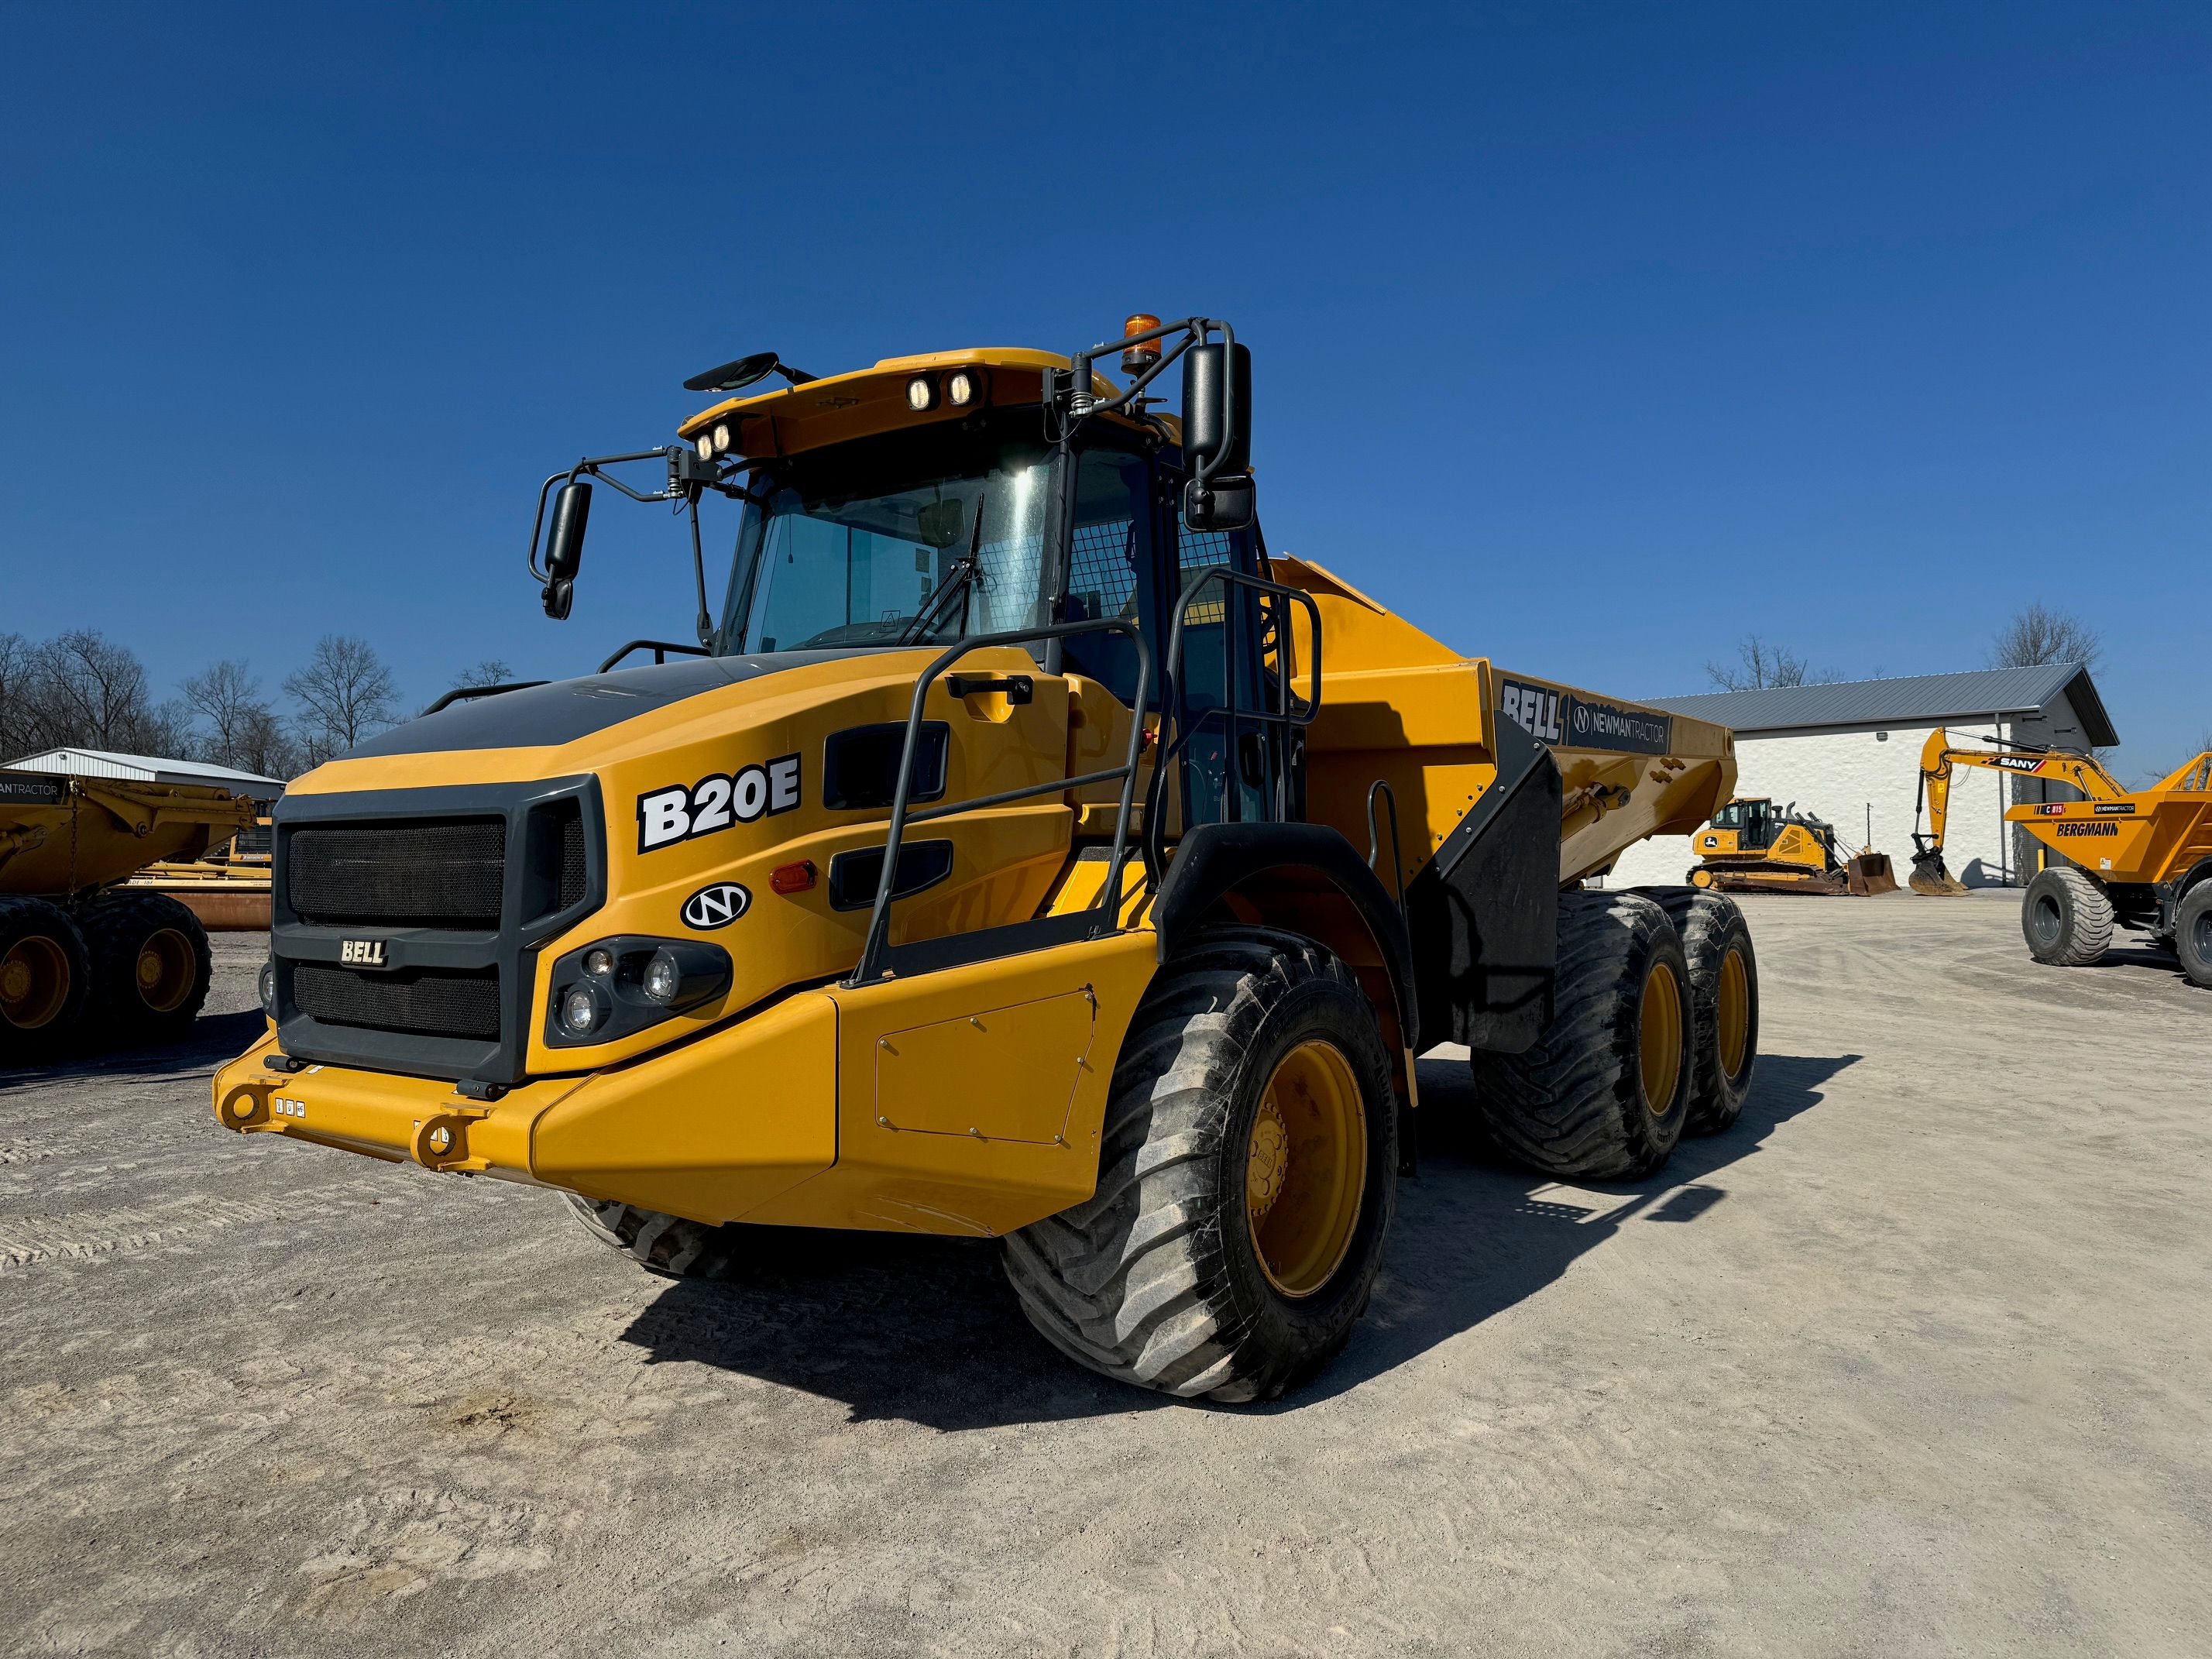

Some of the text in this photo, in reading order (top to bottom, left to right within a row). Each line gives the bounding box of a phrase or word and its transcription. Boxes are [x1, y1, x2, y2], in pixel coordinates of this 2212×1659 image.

[1503, 685, 1560, 740] BELL
[1593, 712, 1664, 744] NEWMANTRACTOR
[2000, 757, 2037, 770] SANY
[642, 758, 798, 847] B20E
[2056, 822, 2119, 837] BERGMANN
[341, 940, 383, 964] BELL
[1257, 1149, 1271, 1168] BELL
